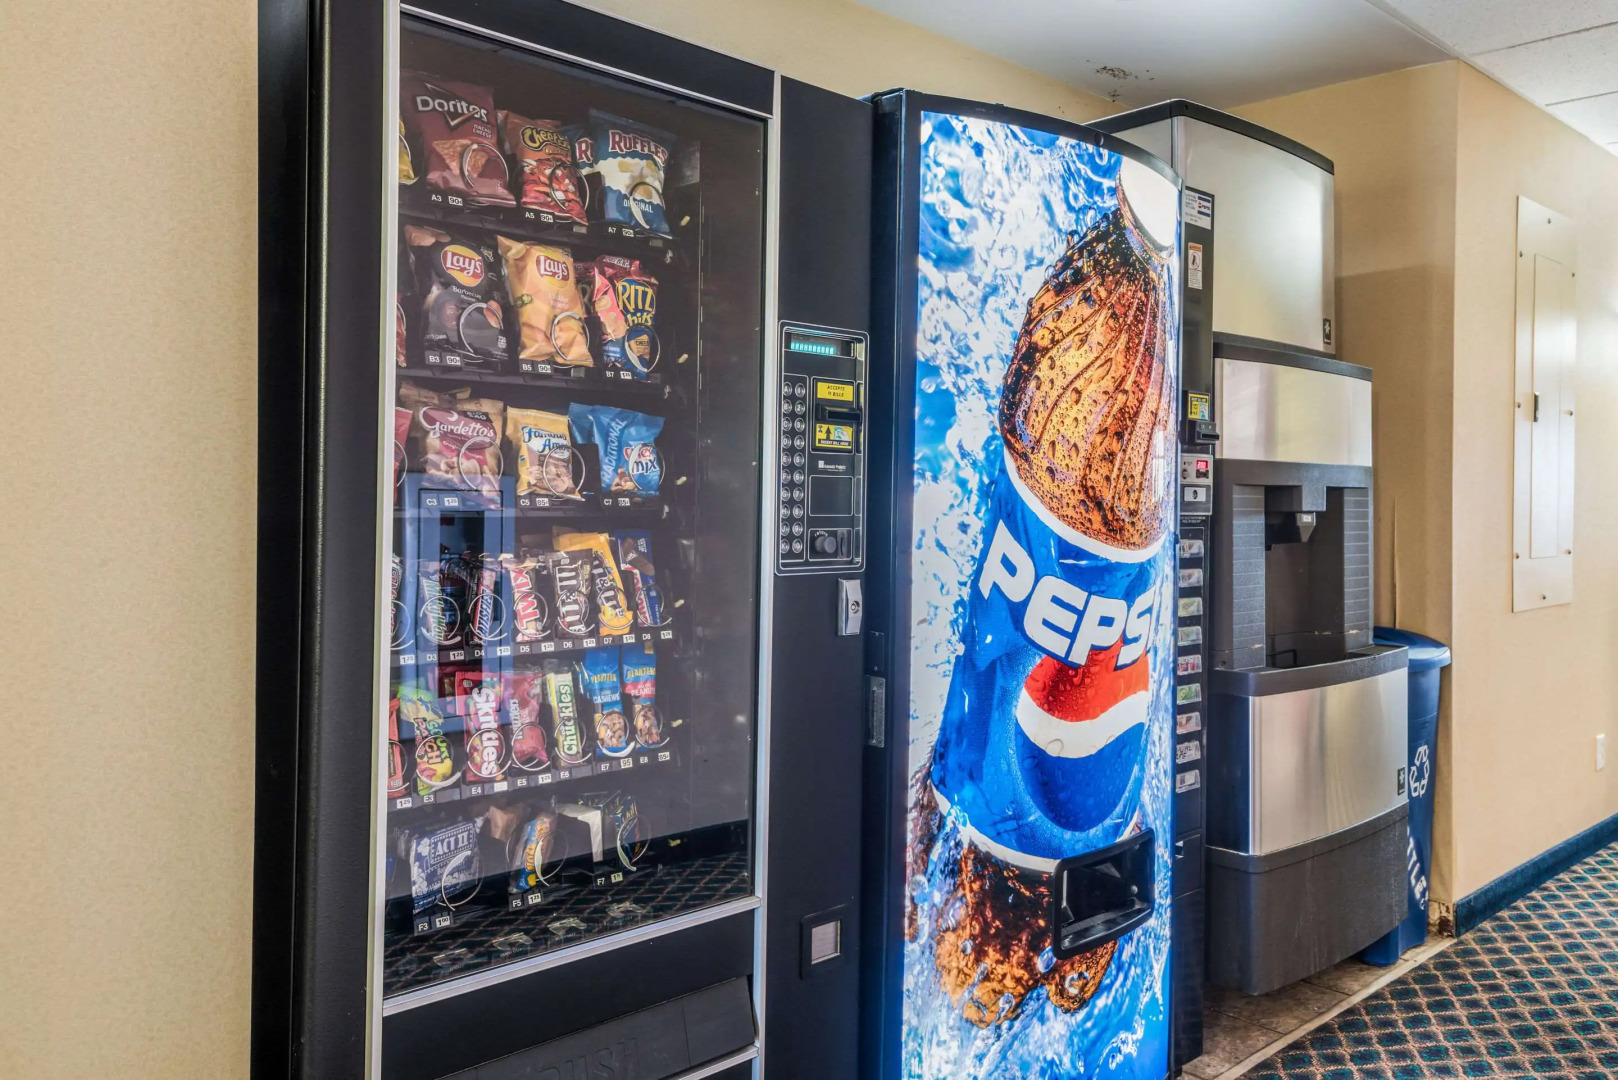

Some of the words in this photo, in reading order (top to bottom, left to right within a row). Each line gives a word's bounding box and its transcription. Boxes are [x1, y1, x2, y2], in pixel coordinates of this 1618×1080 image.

[416, 95, 489, 123] Doritos
[523, 126, 571, 150] Cheetos
[609, 129, 669, 165] RUFFLES
[446, 251, 484, 277] Lay's
[539, 255, 568, 281] Lay's
[617, 281, 653, 313] RITZ
[419, 406, 494, 438] Gardetto's
[510, 568, 540, 631] TWIX
[520, 645, 530, 653] D5
[592, 694, 620, 704] CASHEWS
[471, 687, 500, 776] Skittles
[559, 684, 578, 756] Chuckles
[560, 771, 570, 779] E6
[601, 763, 609, 771] E7
[471, 786, 482, 794] E4
[517, 779, 527, 787] E5
[423, 795, 434, 803] E3
[435, 837, 456, 857] ACT
[457, 831, 470, 849] II
[597, 877, 605, 886] F7
[512, 899, 522, 907] F5
[418, 923, 429, 932] F3
